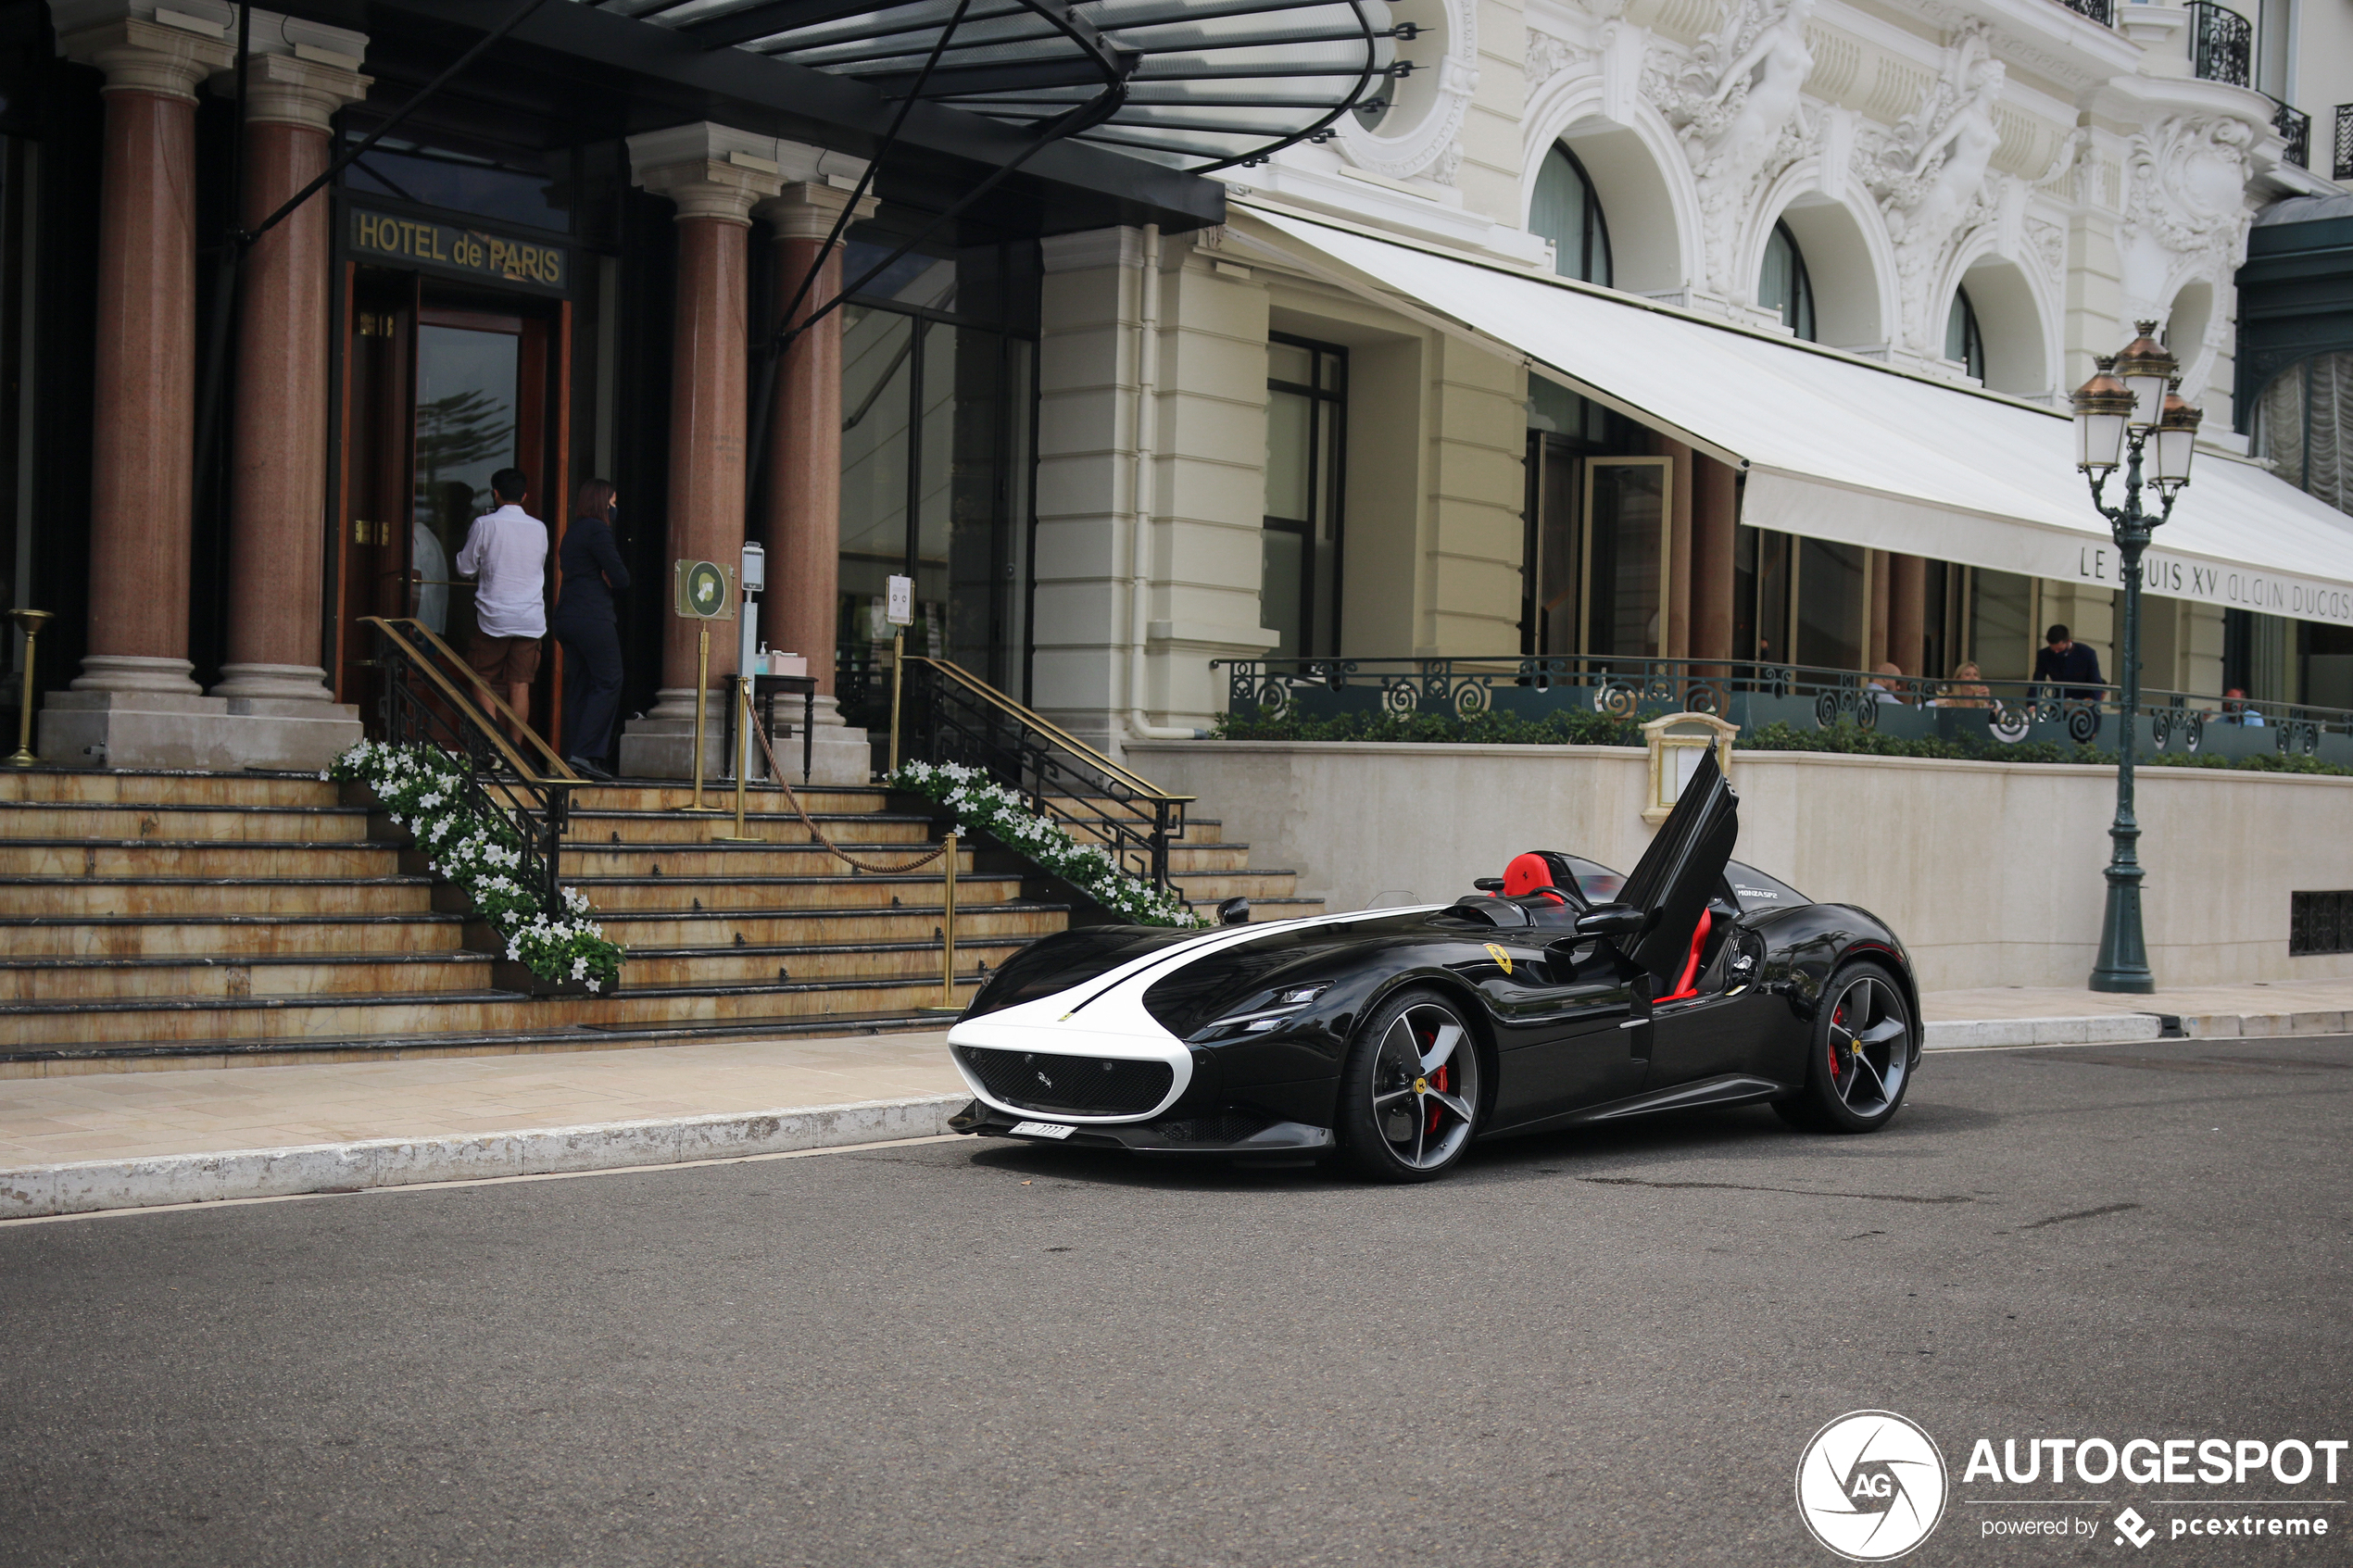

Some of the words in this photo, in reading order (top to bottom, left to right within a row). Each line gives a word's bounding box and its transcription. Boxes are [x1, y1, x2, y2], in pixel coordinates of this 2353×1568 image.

[359, 213, 447, 261] HOTEL
[453, 233, 482, 268] de
[489, 239, 560, 282] PARIS
[2081, 546, 2106, 579] LE
[2192, 566, 2218, 596] XV
[1737, 889, 1764, 897] MONZA
